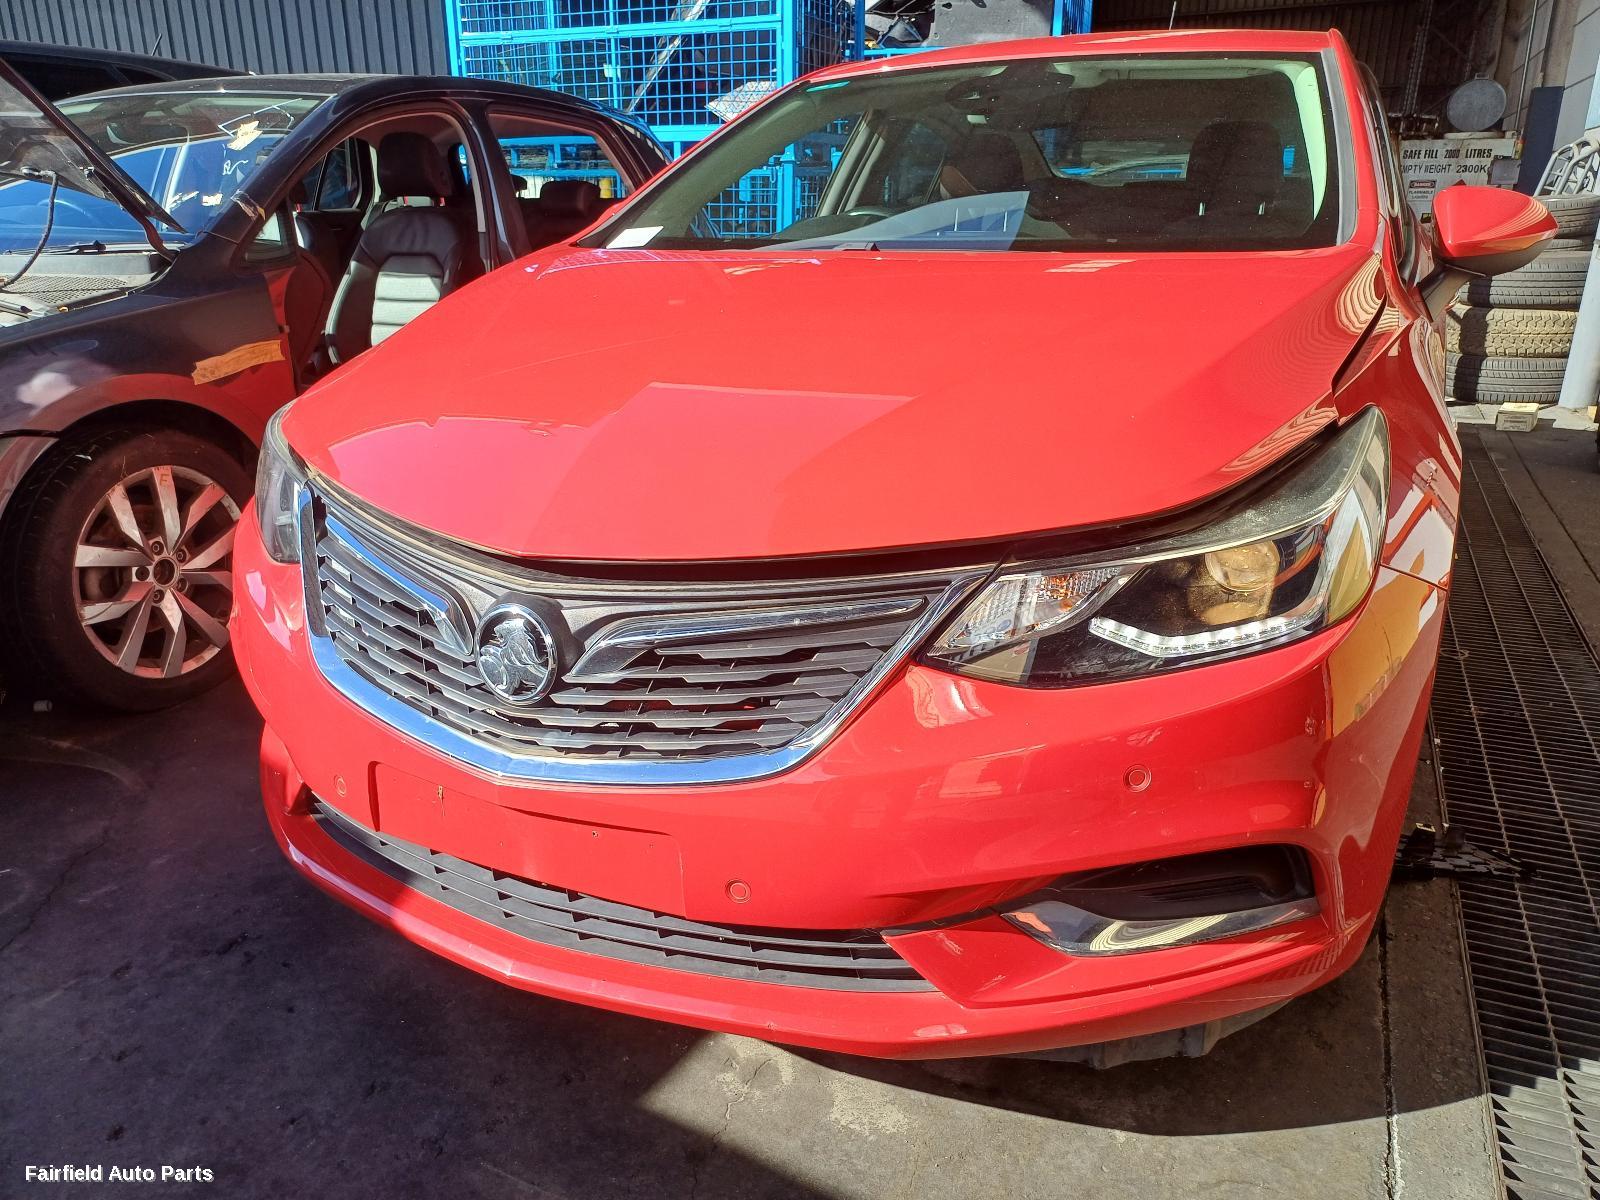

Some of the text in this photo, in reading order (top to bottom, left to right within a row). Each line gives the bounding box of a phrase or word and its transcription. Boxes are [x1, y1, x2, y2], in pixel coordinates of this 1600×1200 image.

[1402, 149, 1421, 159] SAFE
[1423, 149, 1438, 159] FILL
[1465, 148, 1492, 159] LITRES
[1401, 163, 1423, 174] MPTY
[1424, 164, 1452, 174] WEIGHT
